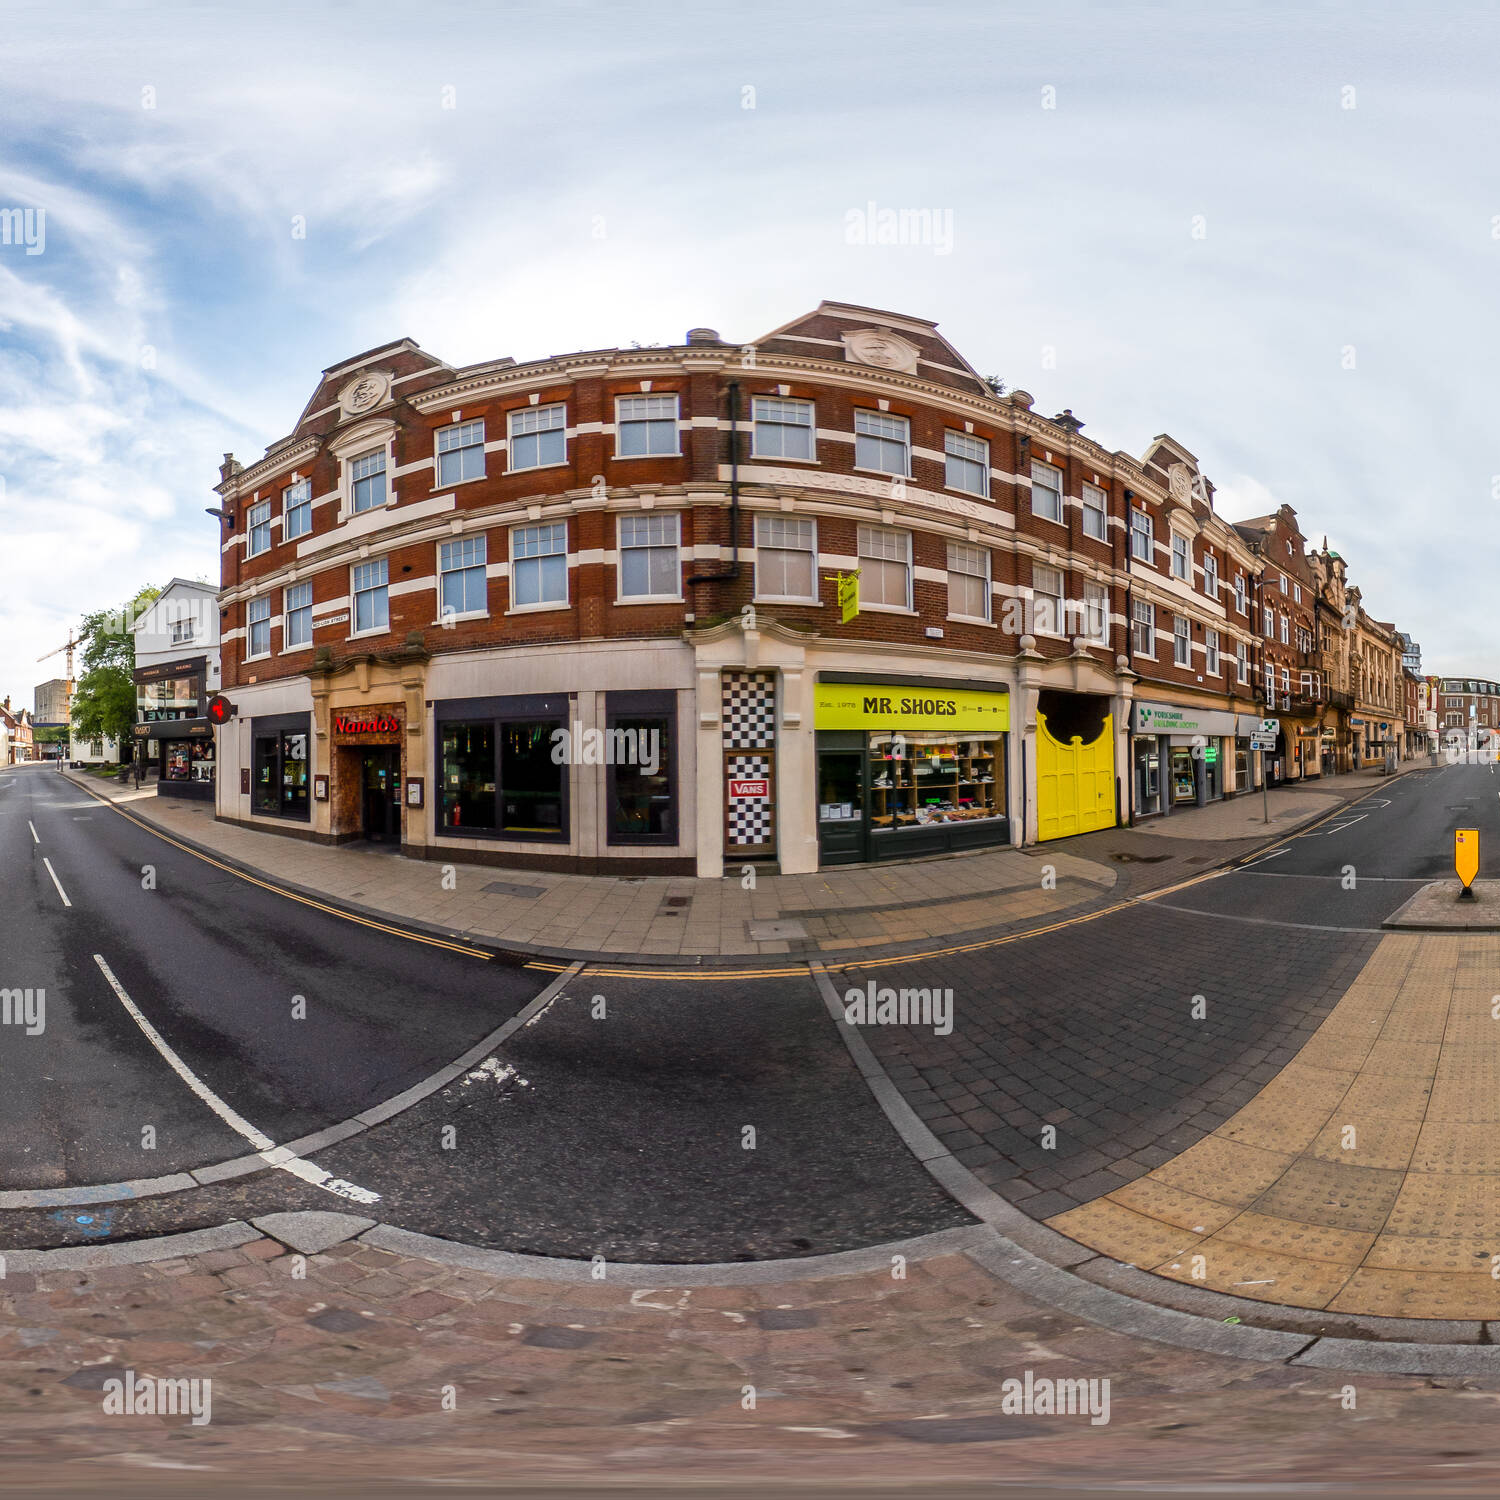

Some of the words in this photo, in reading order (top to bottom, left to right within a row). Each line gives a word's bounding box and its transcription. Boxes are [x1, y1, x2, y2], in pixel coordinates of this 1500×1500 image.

[863, 697, 898, 714] MR.
[900, 698, 957, 716] SHOES
[1154, 711, 1183, 720] YORKSHIRE
[335, 714, 400, 734] Nando's
[1153, 719, 1178, 729] BUILDING
[1179, 721, 1199, 729] SOCIETY
[734, 783, 765, 794] VANS
